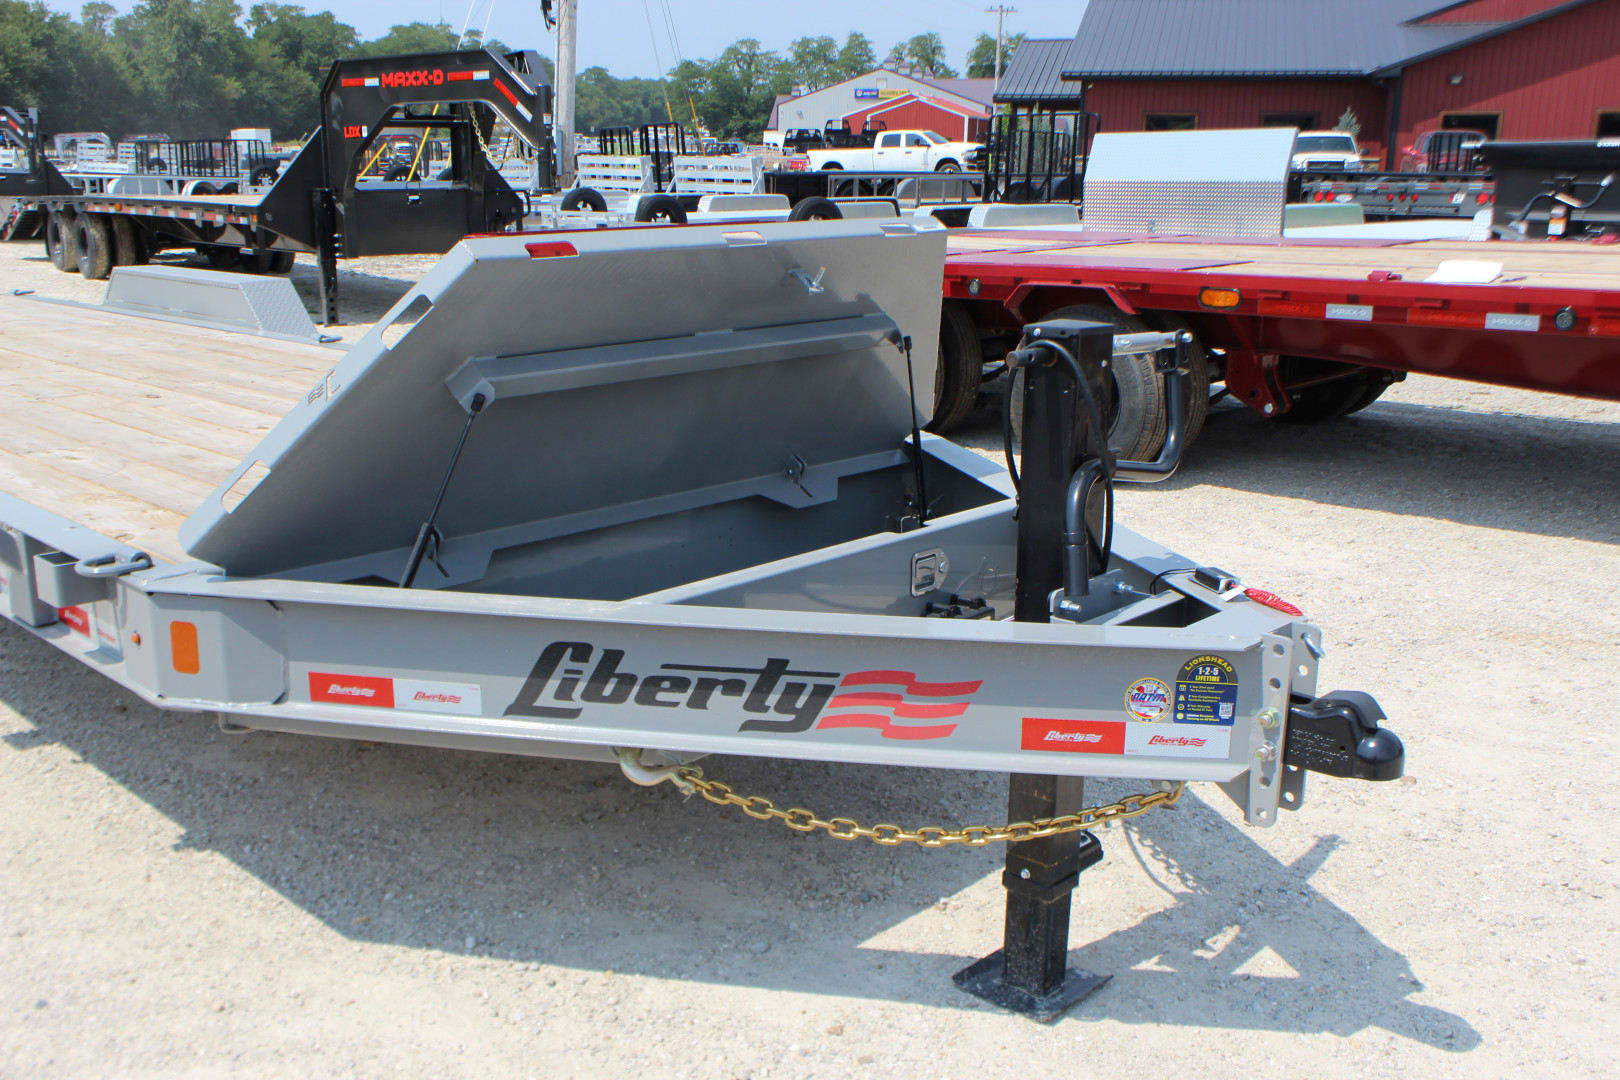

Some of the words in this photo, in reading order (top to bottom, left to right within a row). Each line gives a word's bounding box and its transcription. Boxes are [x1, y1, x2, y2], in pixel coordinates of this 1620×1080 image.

[343, 125, 361, 138] LDX
[1185, 655, 1233, 673] LIONSHEAD
[327, 684, 362, 697] Liberty
[502, 640, 840, 733] Liberty
[413, 691, 448, 703] Liberty
[1043, 730, 1085, 743] Liberty
[1147, 735, 1190, 747] Liberty
